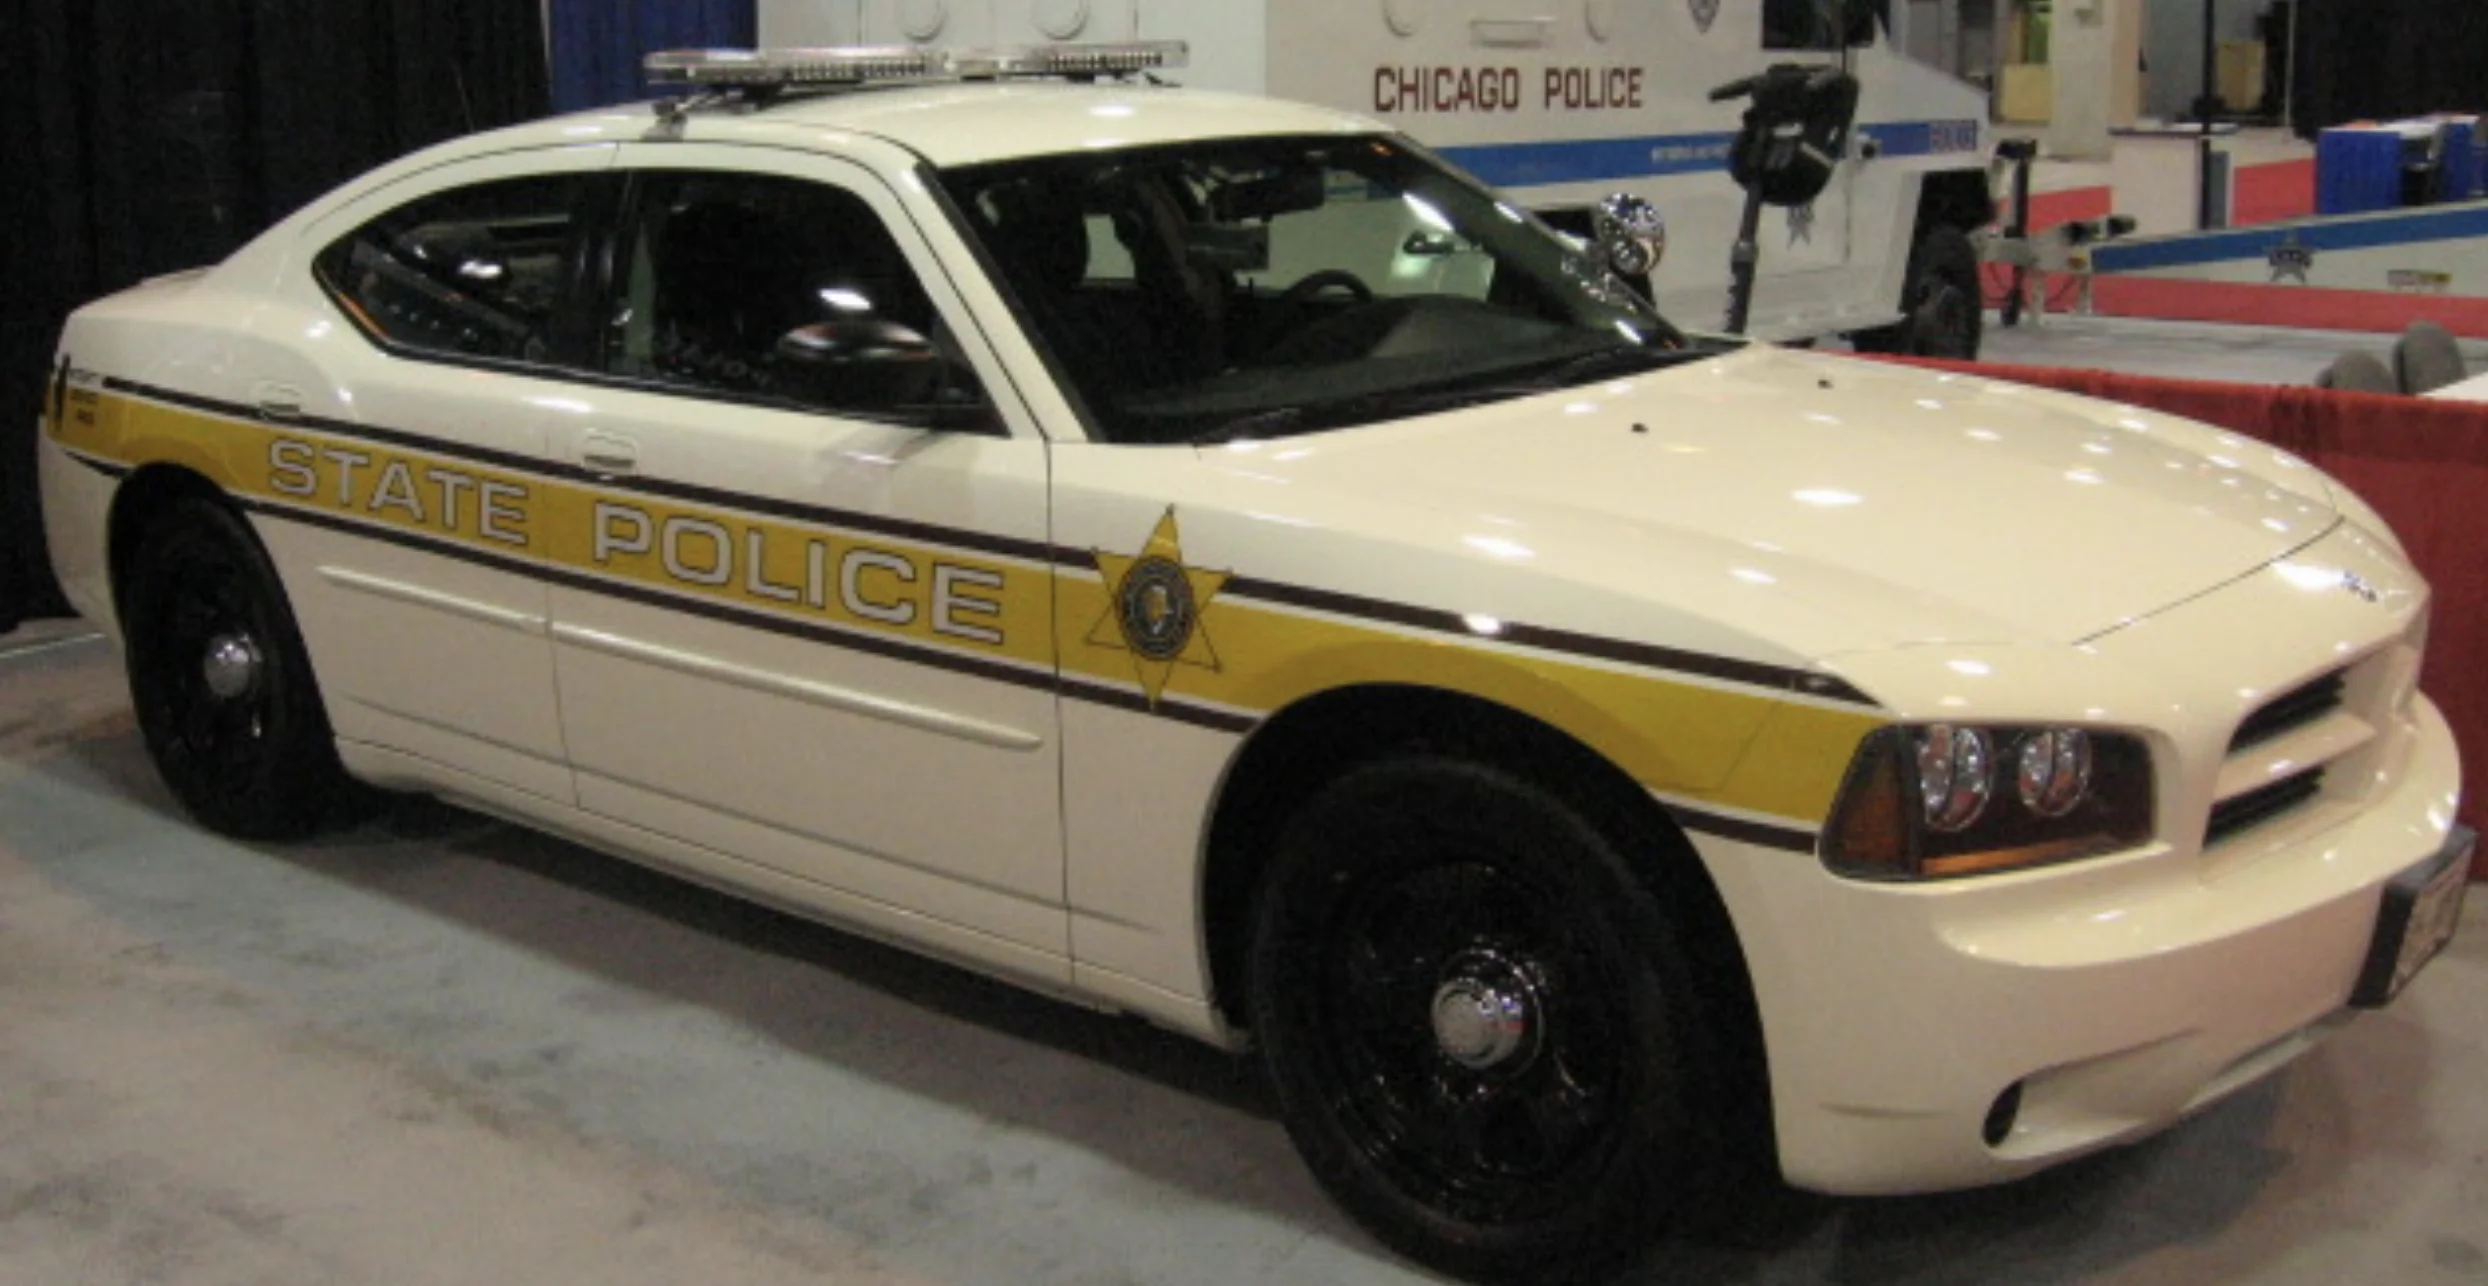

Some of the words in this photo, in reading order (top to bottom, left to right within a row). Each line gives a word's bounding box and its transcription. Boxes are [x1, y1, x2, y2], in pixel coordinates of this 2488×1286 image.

[1374, 67, 1519, 112] CHICAGO
[1543, 68, 1643, 109] POLICE
[267, 438, 529, 546] STATE
[593, 501, 1005, 646] POLICE
